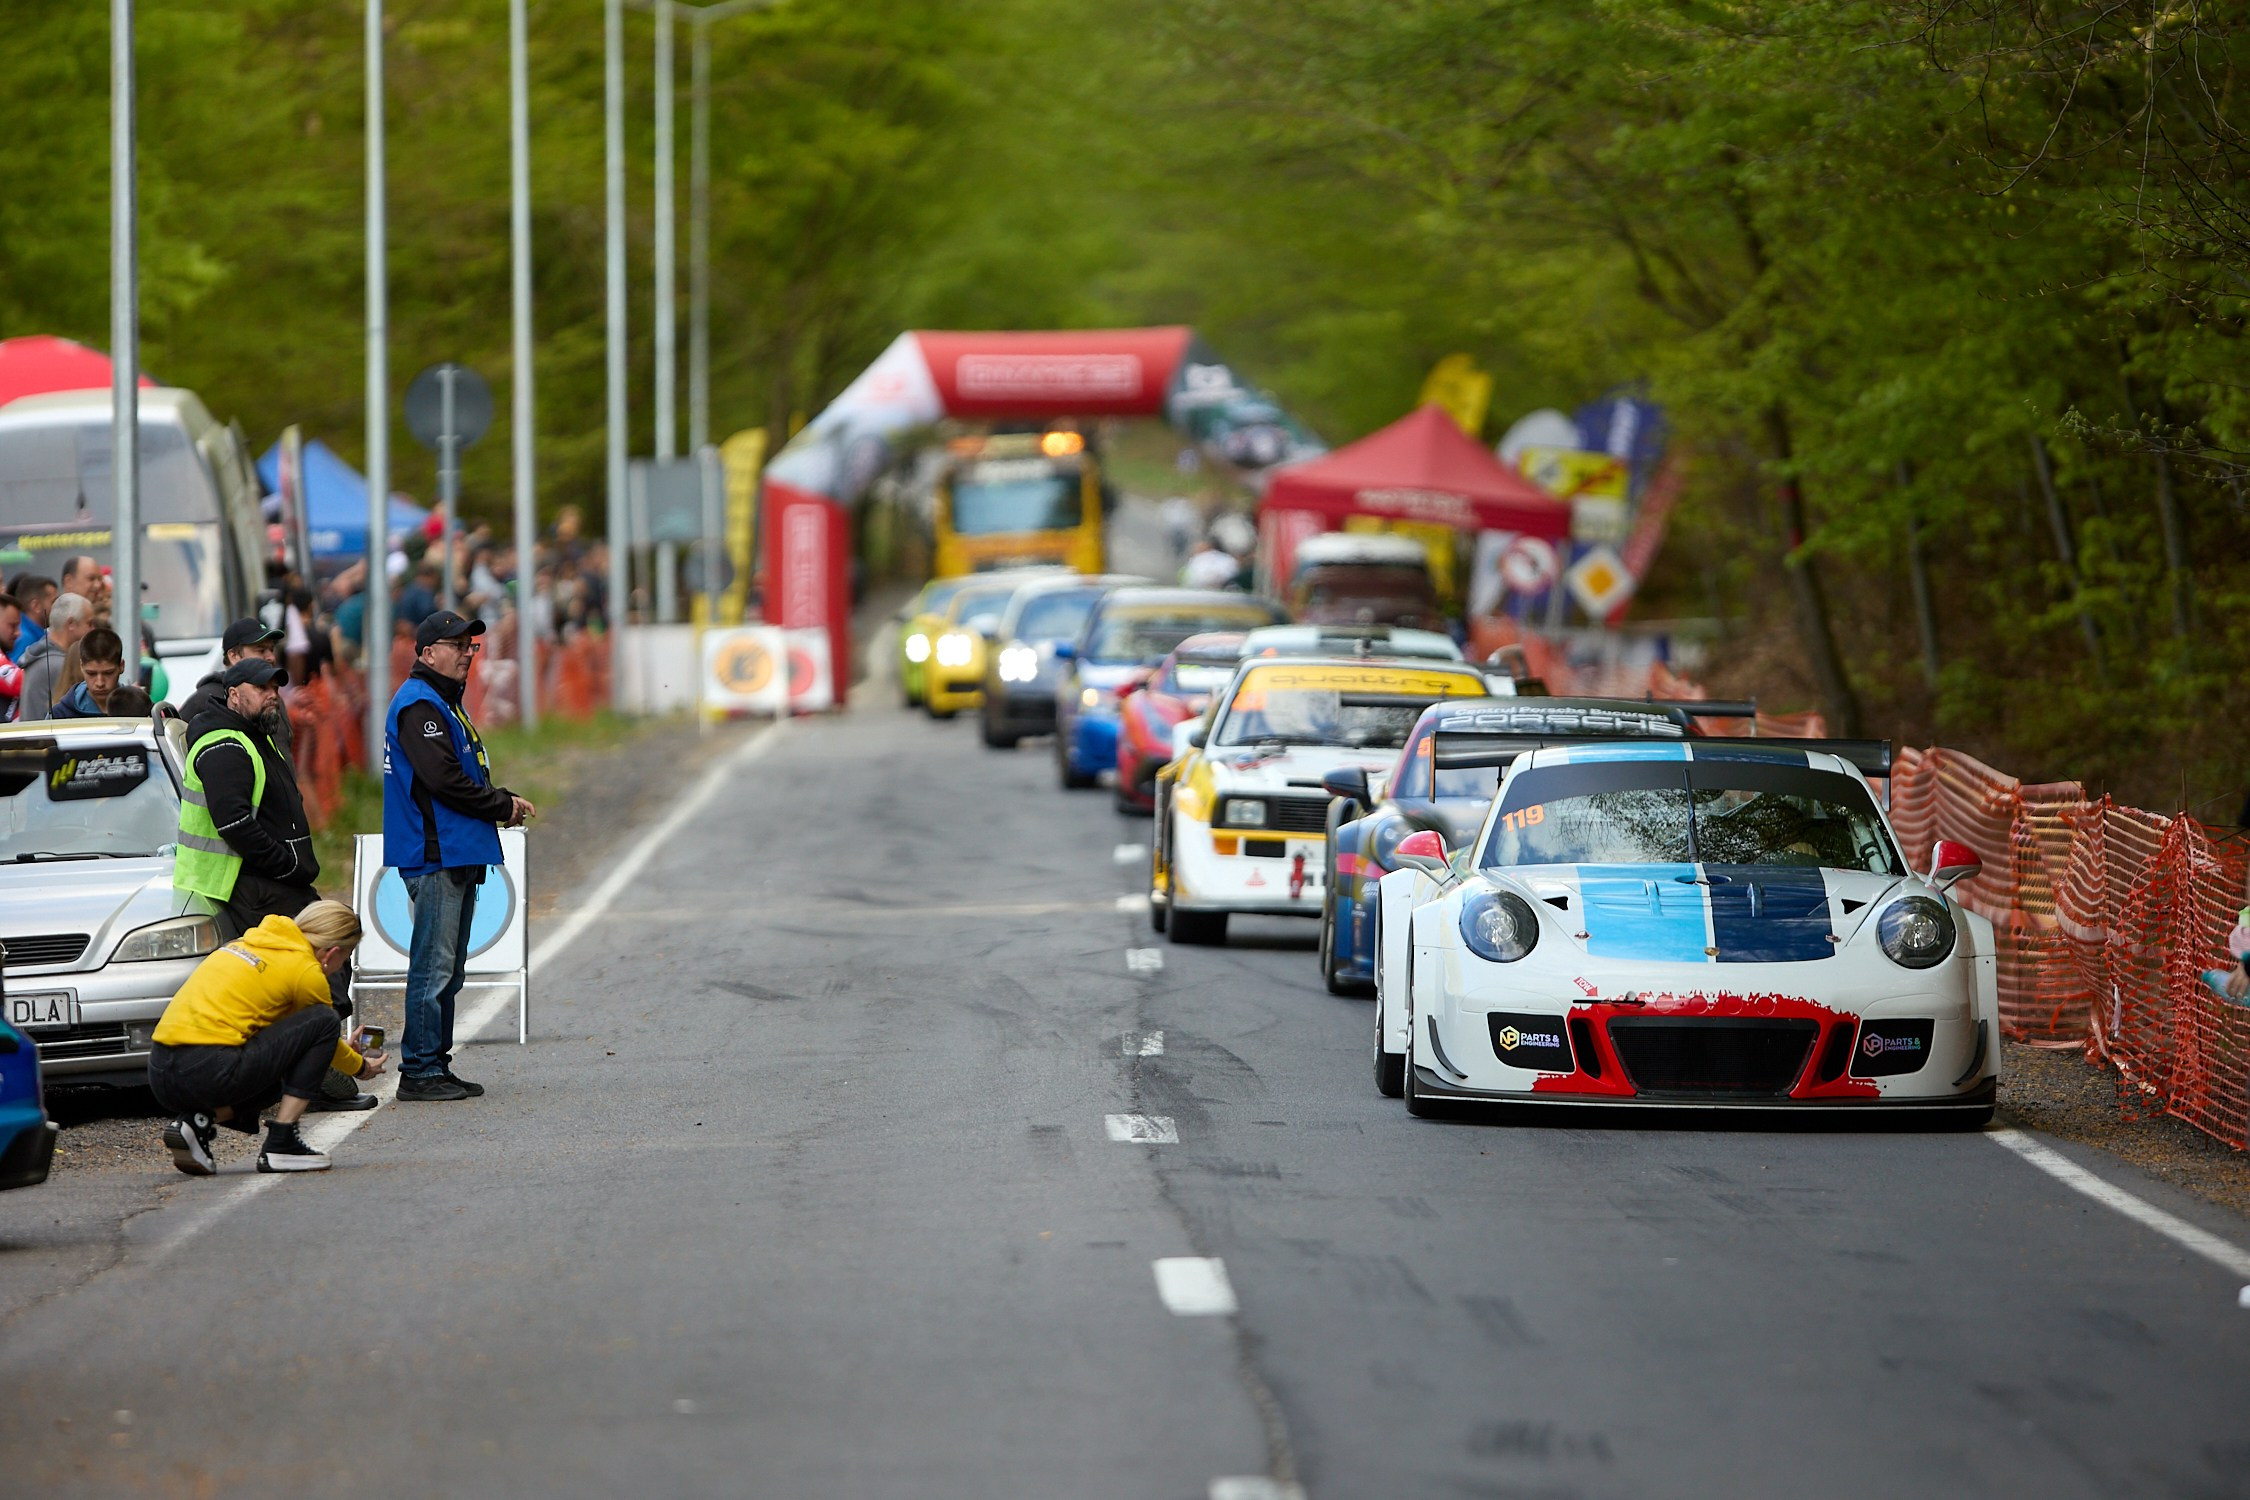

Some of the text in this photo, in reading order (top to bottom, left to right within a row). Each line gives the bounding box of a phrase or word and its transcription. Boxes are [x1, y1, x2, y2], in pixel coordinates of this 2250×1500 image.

[1269, 673, 1452, 689] quattro
[1455, 706, 1515, 716] Centrul
[1518, 706, 1587, 715] Porsche
[1440, 713, 1684, 737] PORSCHE
[77, 754, 140, 769] IMPULS
[74, 763, 145, 780] LEASING
[1502, 804, 1544, 833] 119
[1576, 977, 1593, 992] TOW
[13, 999, 61, 1023] DLA
[1520, 1032, 1560, 1043] PARTS &
[1520, 1040, 1560, 1048] ENGINEERING
[1884, 1037, 1921, 1045] PARTS &
